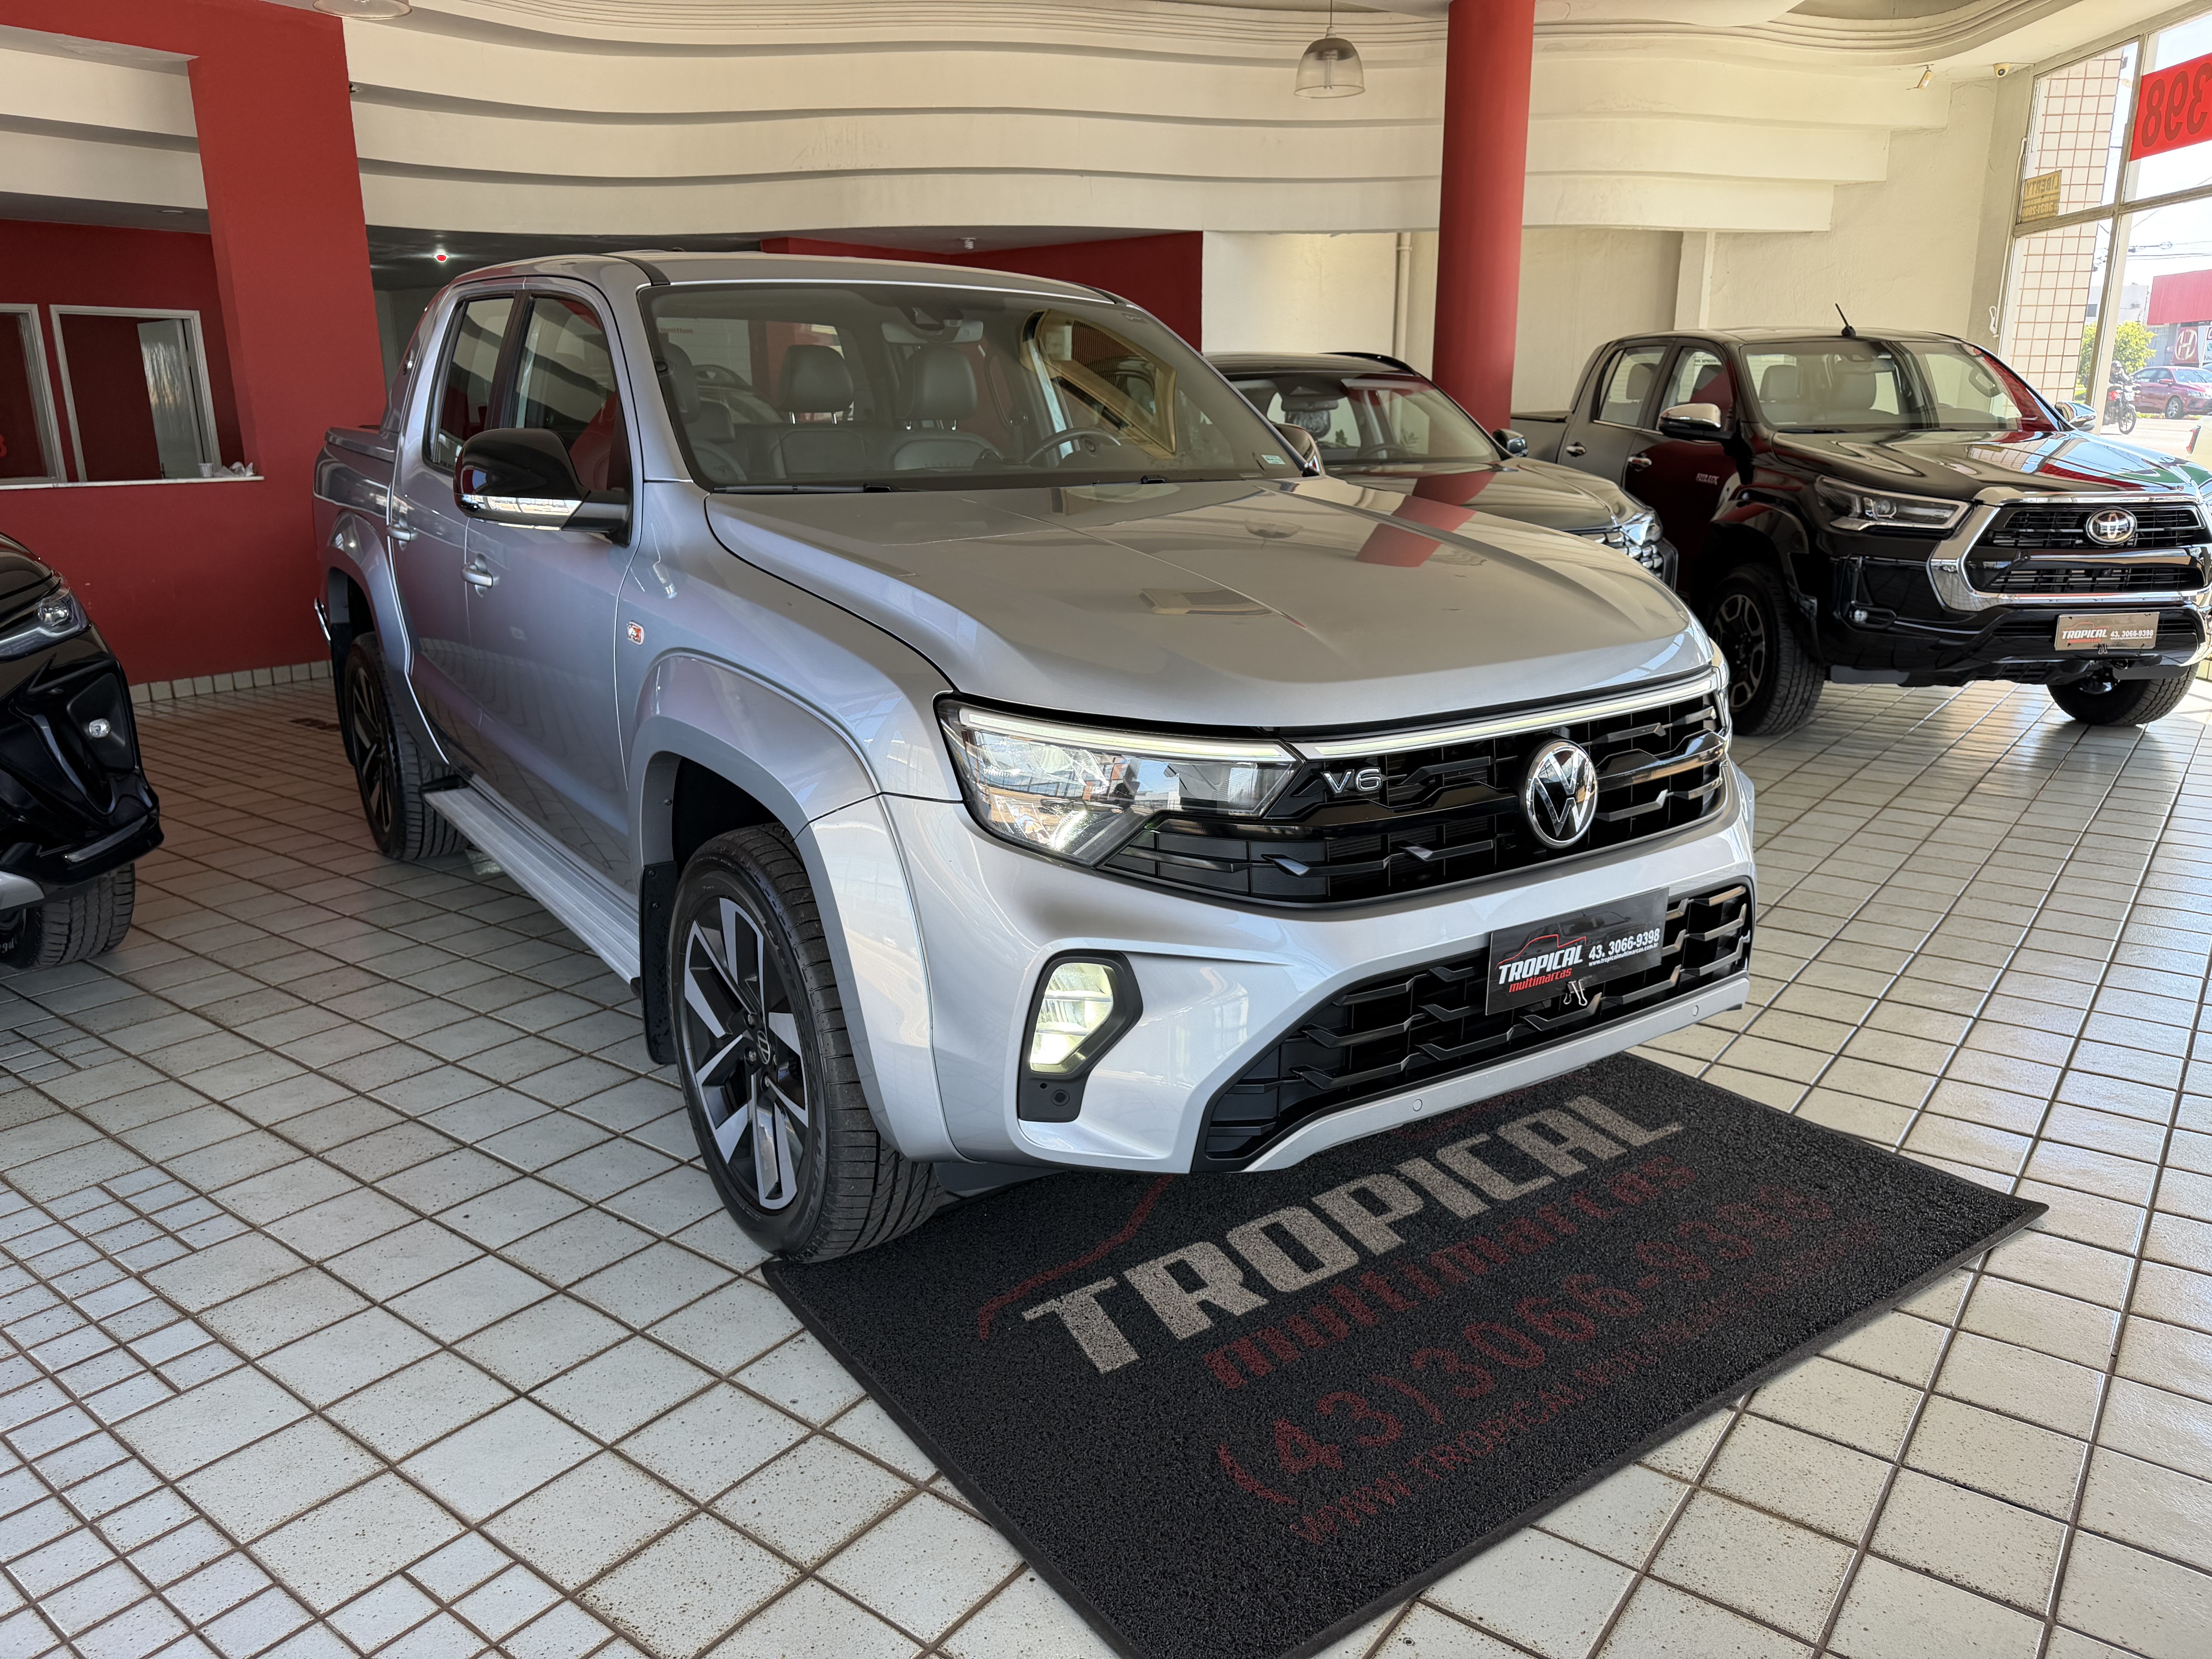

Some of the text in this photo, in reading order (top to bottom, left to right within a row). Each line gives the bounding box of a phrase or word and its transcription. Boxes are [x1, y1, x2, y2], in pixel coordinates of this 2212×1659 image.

[2062, 629, 2107, 639] TROPICAL
[1323, 766, 1383, 795] V6
[1589, 928, 1660, 960] 43. 3066-9398
[1499, 945, 1583, 984] TROPICAL
[1509, 968, 1572, 993] multimarcas
[1022, 1094, 1684, 1375] TROPICAL
[1203, 1156, 1698, 1389] multimarcas
